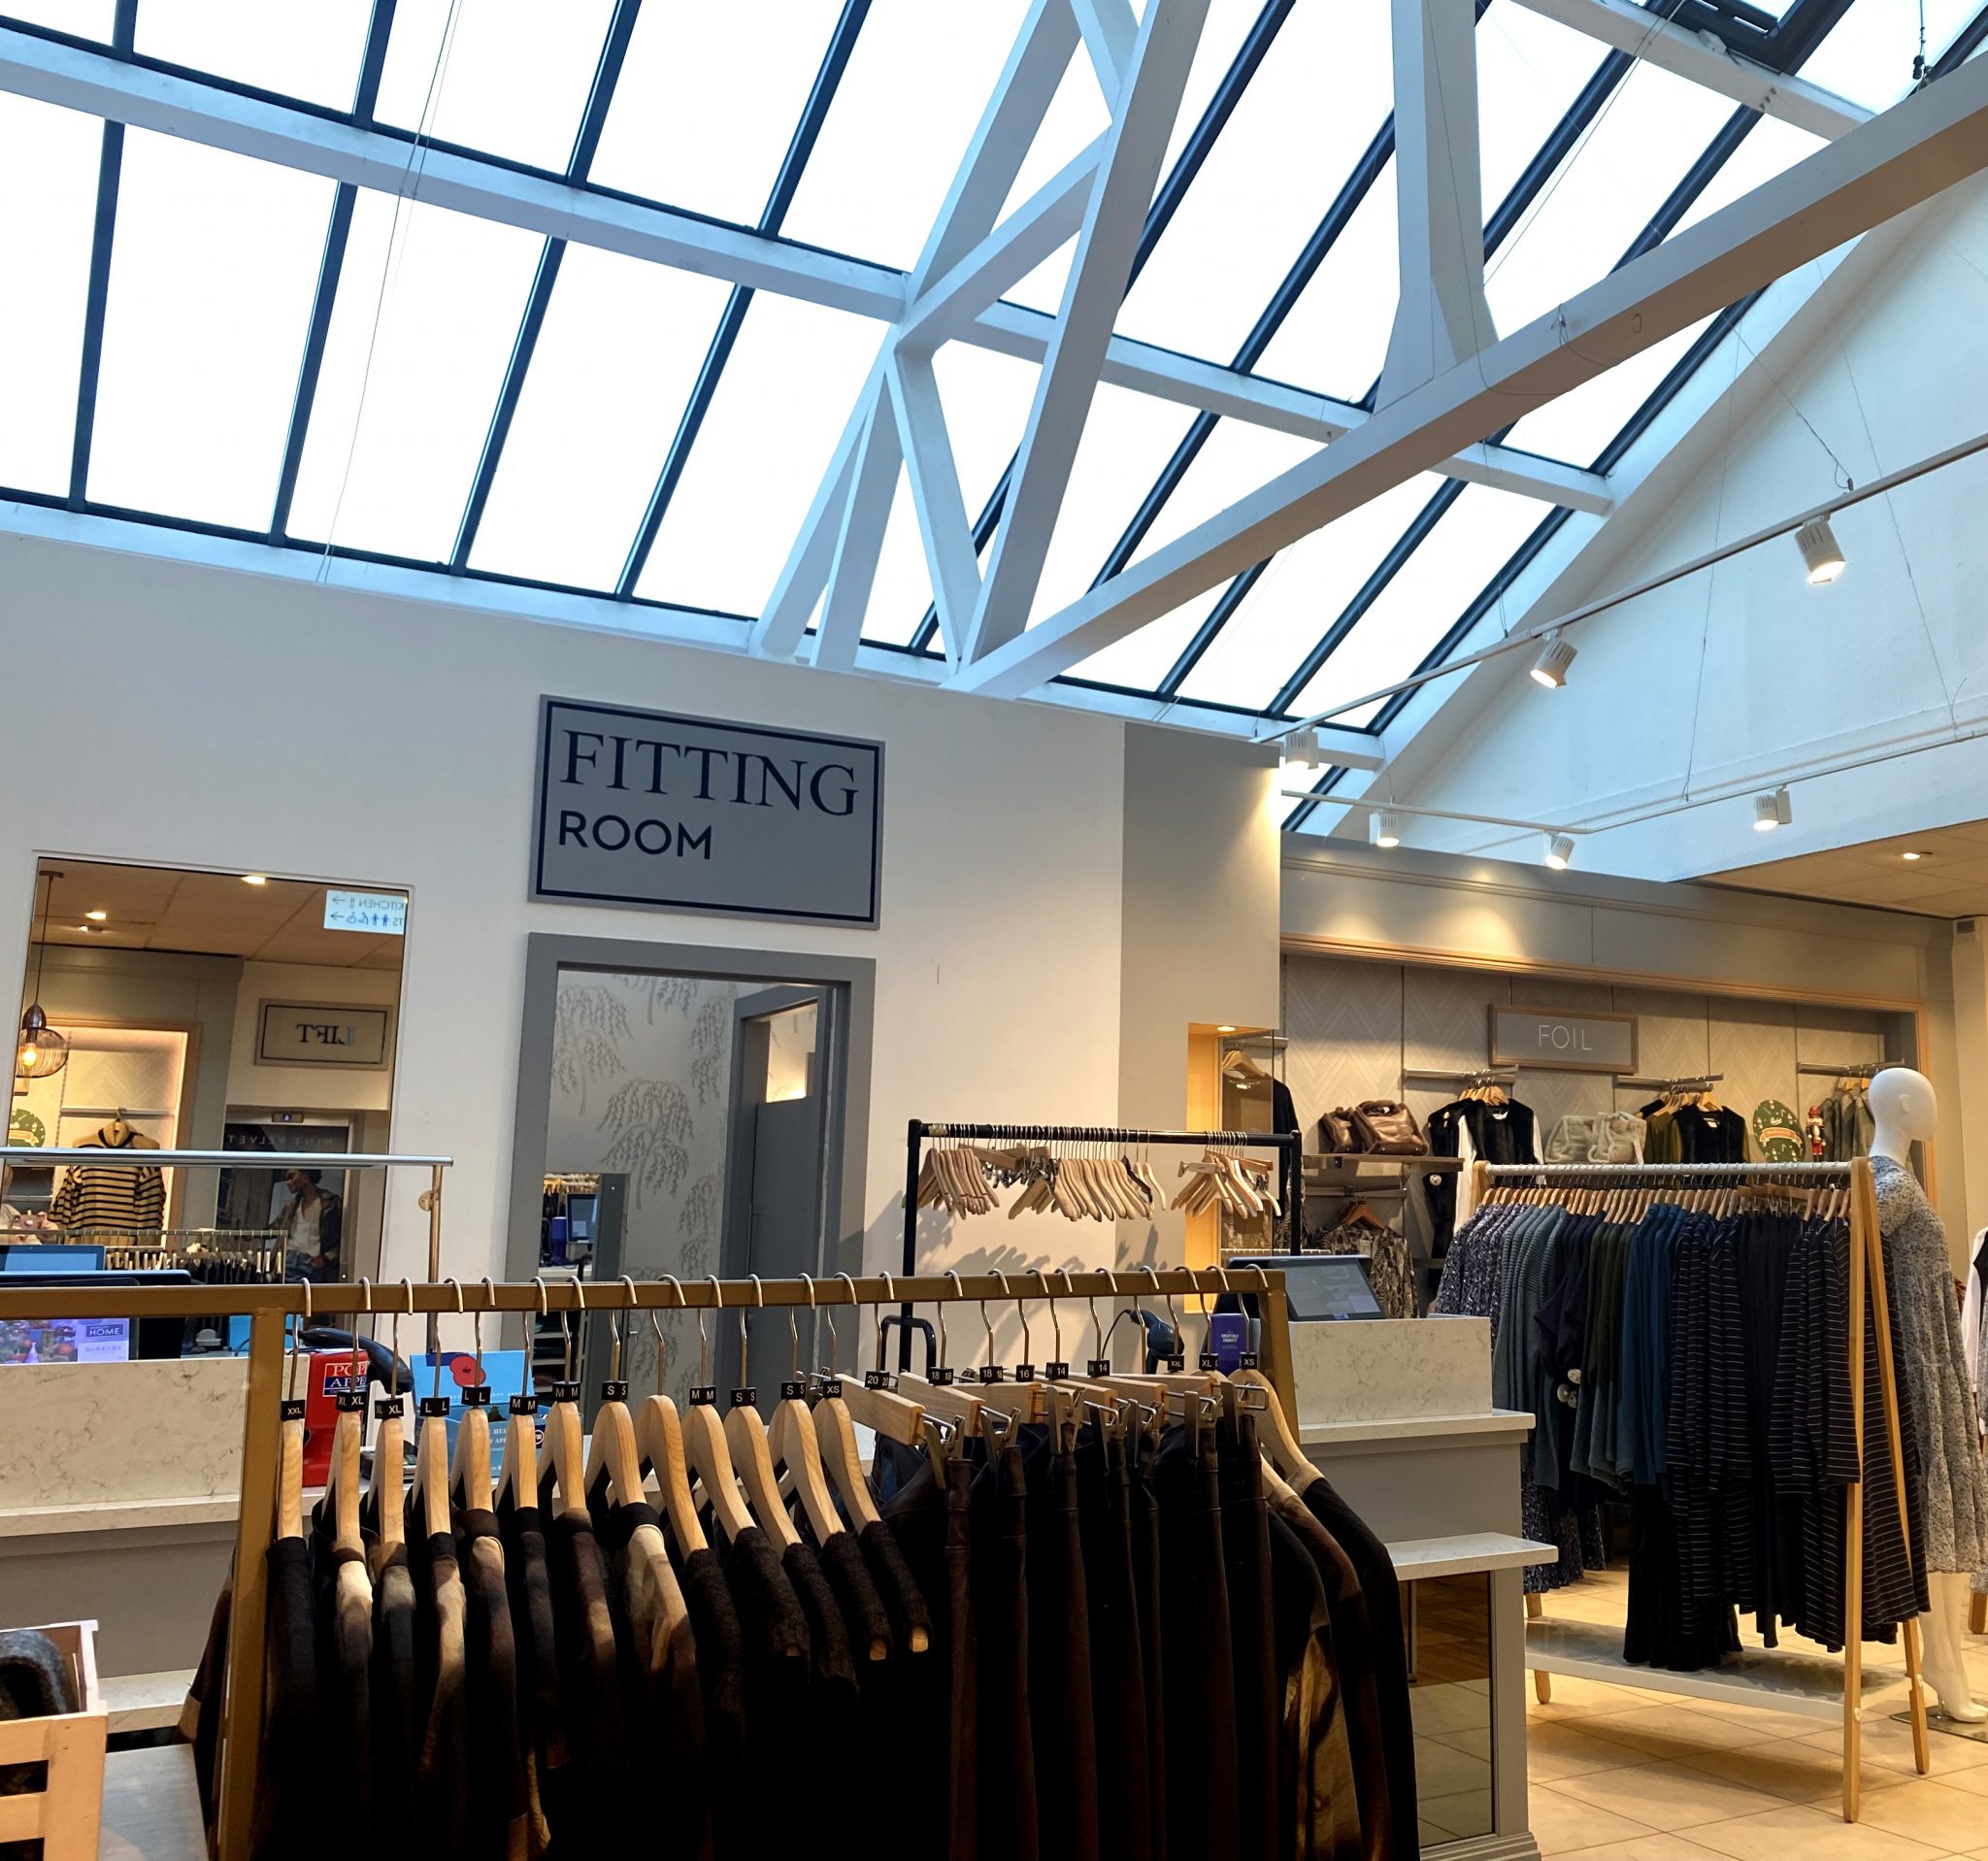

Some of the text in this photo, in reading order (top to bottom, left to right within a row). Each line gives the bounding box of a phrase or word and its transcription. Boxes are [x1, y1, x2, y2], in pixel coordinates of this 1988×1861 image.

[559, 729, 859, 816] FITTING
[558, 809, 712, 860] ROOM
[1539, 1024, 1593, 1050] FOIL
[89, 1327, 120, 1336] HOME
[1057, 1367, 1066, 1376] 14
[1099, 1363, 1108, 1373] 14
[932, 1371, 940, 1380] 18
[983, 1369, 992, 1379] 18
[1019, 1370, 1030, 1379] 16
[867, 1375, 878, 1384] 20
[465, 1389, 469, 1400] L
[555, 1388, 564, 1397] M
[571, 1387, 579, 1397] M
[607, 1385, 614, 1395] S
[622, 1385, 626, 1395] S
[692, 1389, 700, 1399] M
[786, 1385, 794, 1395] S
[827, 1385, 840, 1394] XS
[479, 1392, 485, 1402] L
[707, 1390, 713, 1400] M
[736, 1392, 743, 1403] S
[750, 1391, 755, 1402] S
[338, 1396, 348, 1406] XL
[351, 1396, 364, 1406] XL
[442, 1401, 447, 1411] L
[513, 1398, 520, 1408] M
[528, 1400, 536, 1411] M
[287, 1407, 302, 1415] XXL
[389, 1405, 402, 1414] XL
[425, 1402, 432, 1412] L
